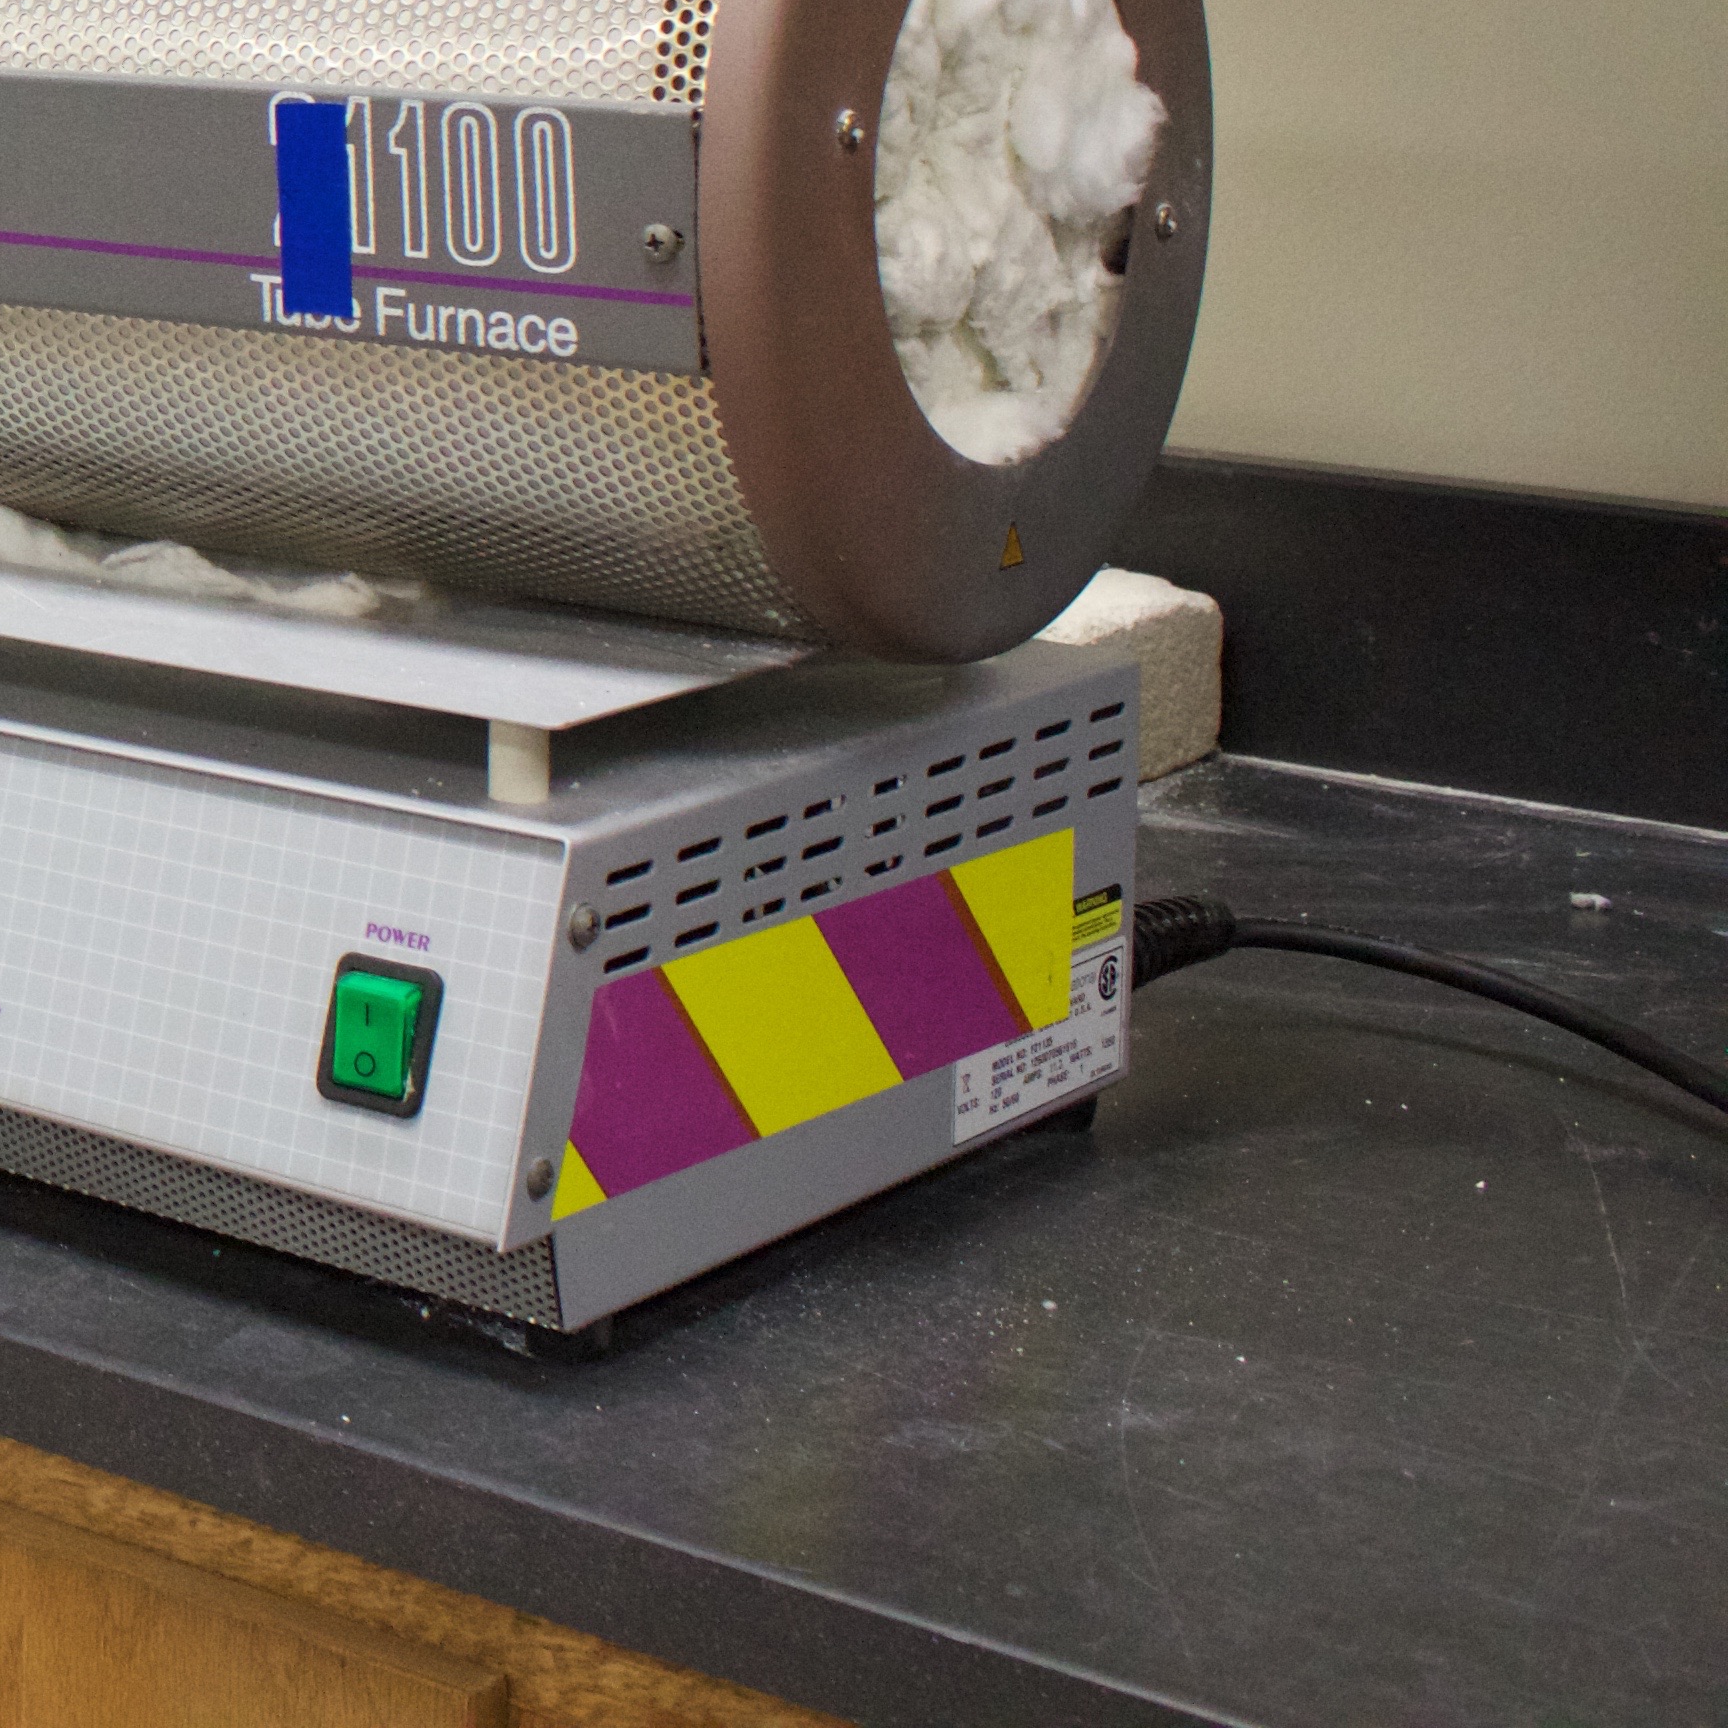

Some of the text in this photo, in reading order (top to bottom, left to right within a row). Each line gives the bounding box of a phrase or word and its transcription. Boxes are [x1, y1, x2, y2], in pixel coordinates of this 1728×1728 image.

[268, 90, 577, 274] 1100
[375, 286, 580, 357] Furnace
[365, 922, 431, 952] POWER
